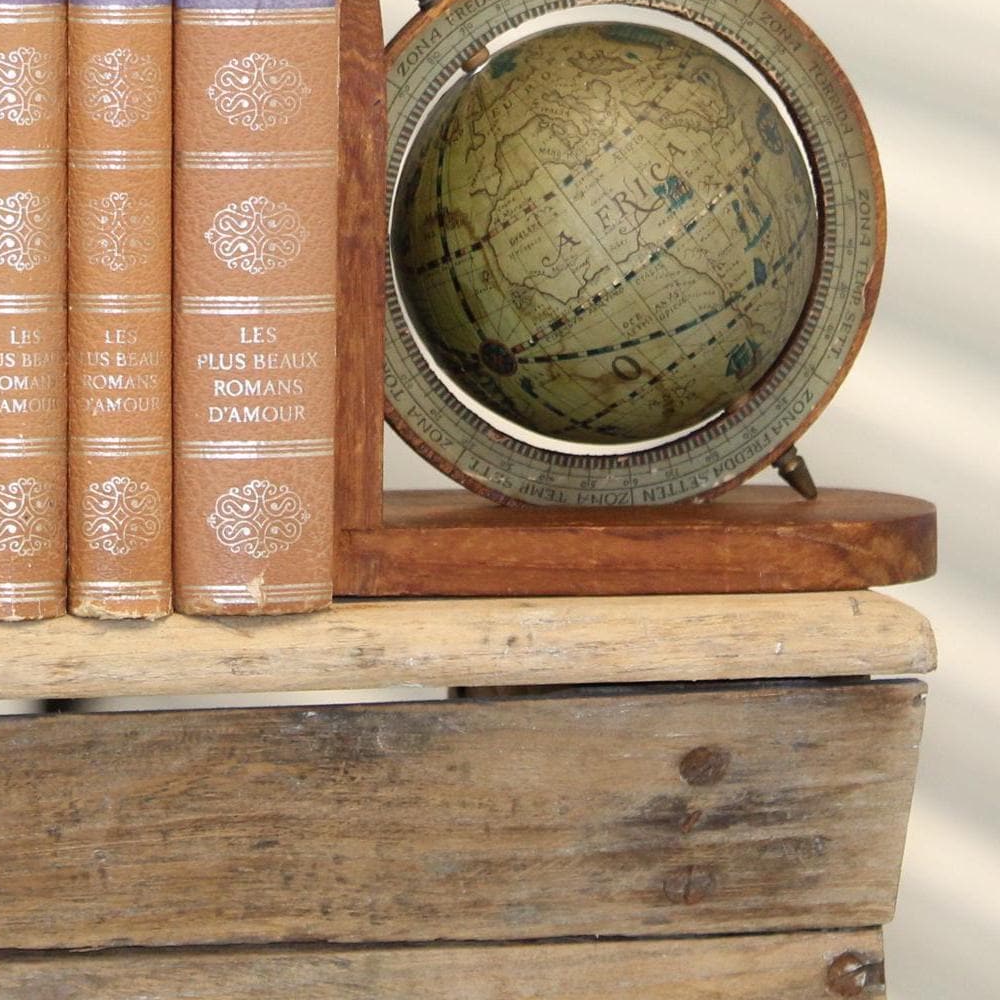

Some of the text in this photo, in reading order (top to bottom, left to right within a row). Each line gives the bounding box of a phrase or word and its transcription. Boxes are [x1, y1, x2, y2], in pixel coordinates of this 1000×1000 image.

[394, 26, 443, 78] ZONA
[857, 188, 871, 246] ZONA
[9, 328, 41, 345] LES
[104, 329, 137, 345] LES
[239, 326, 278, 344] LES
[117, 351, 163, 367] BEAU
[197, 352, 319, 370] PLUS BEAUX
[213, 379, 304, 397] ROMANS
[207, 405, 306, 423] D'AMOUR
[770, 388, 816, 436] ZONA
[405, 403, 453, 452] ZONA
[711, 431, 773, 476] FREDDA
